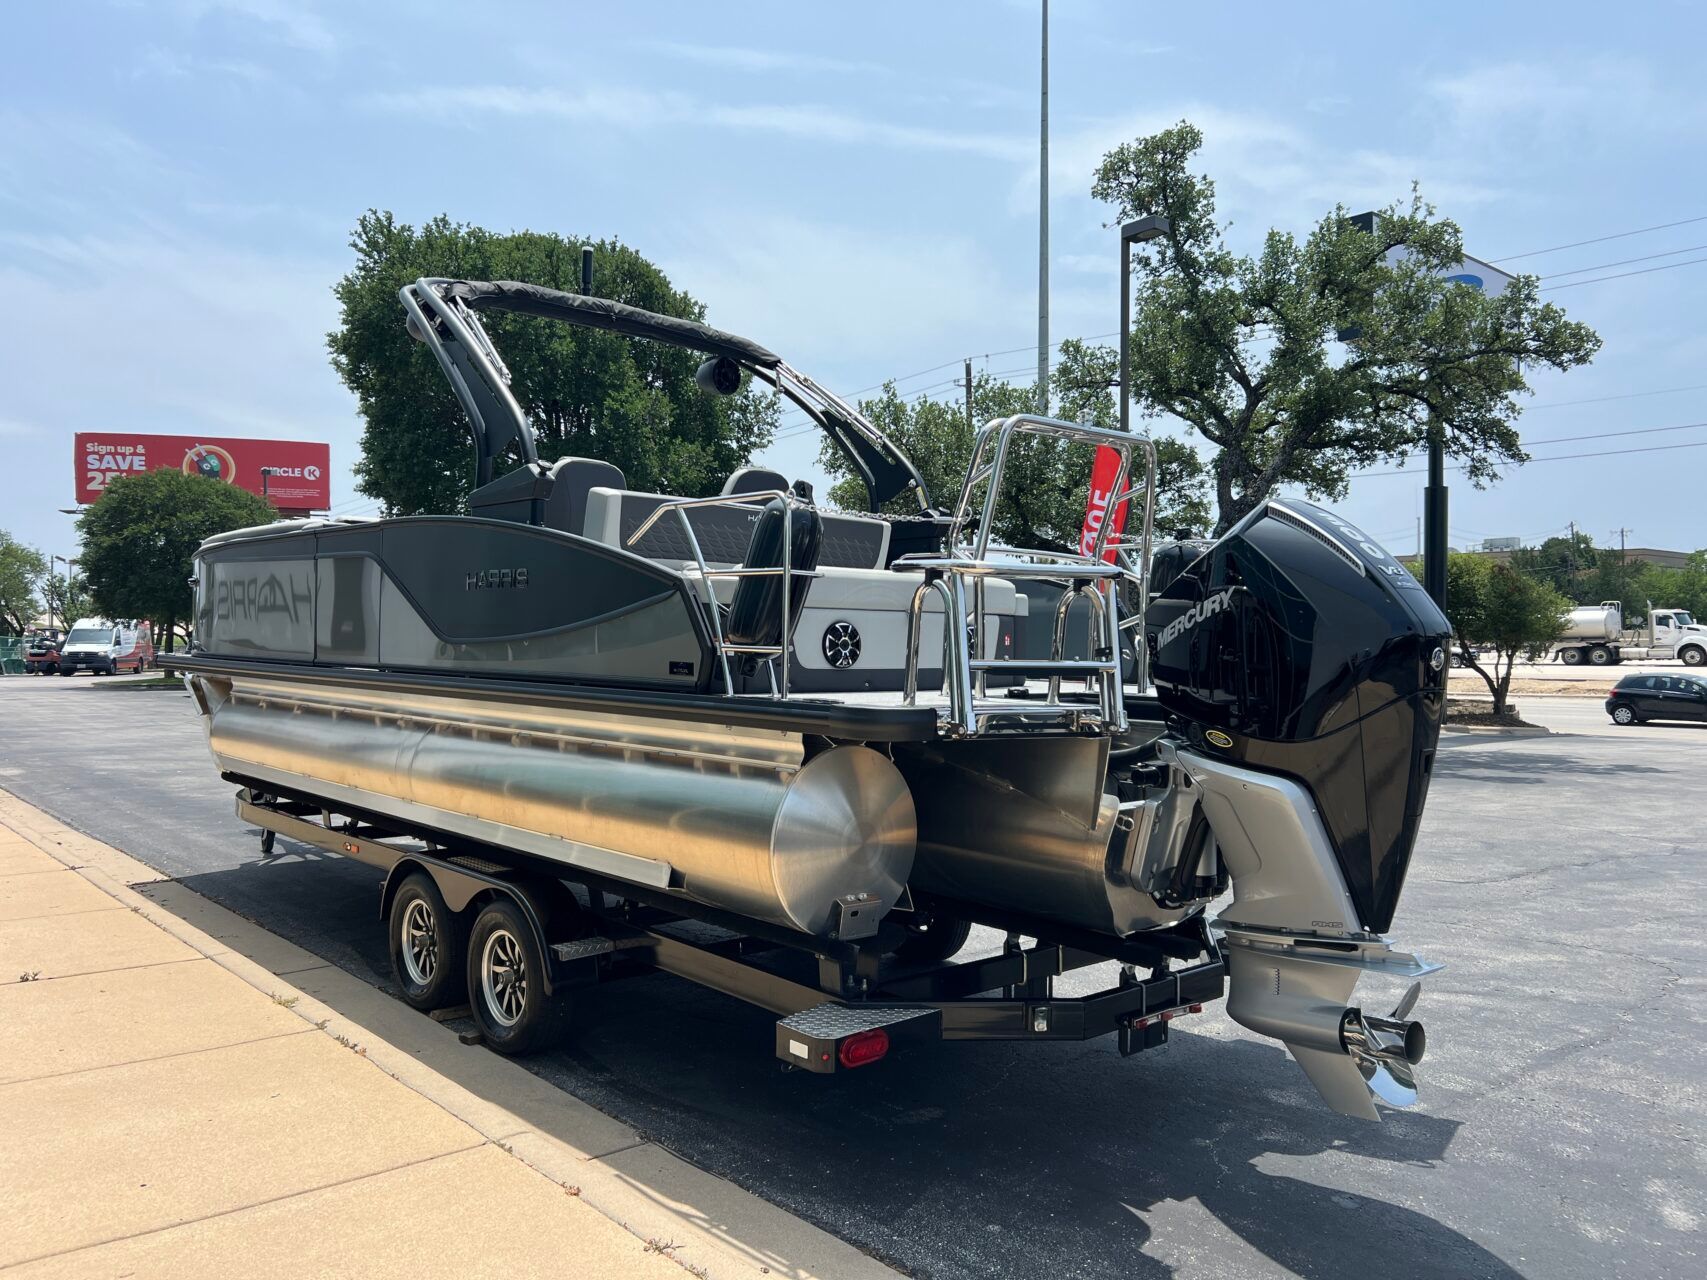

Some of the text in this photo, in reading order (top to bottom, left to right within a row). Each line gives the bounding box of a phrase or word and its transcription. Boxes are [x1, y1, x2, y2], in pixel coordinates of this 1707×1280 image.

[86, 442, 146, 455] Sign up &
[86, 454, 146, 471] SAVE
[306, 467, 319, 480] K
[1157, 585, 1236, 651] MERCURY
